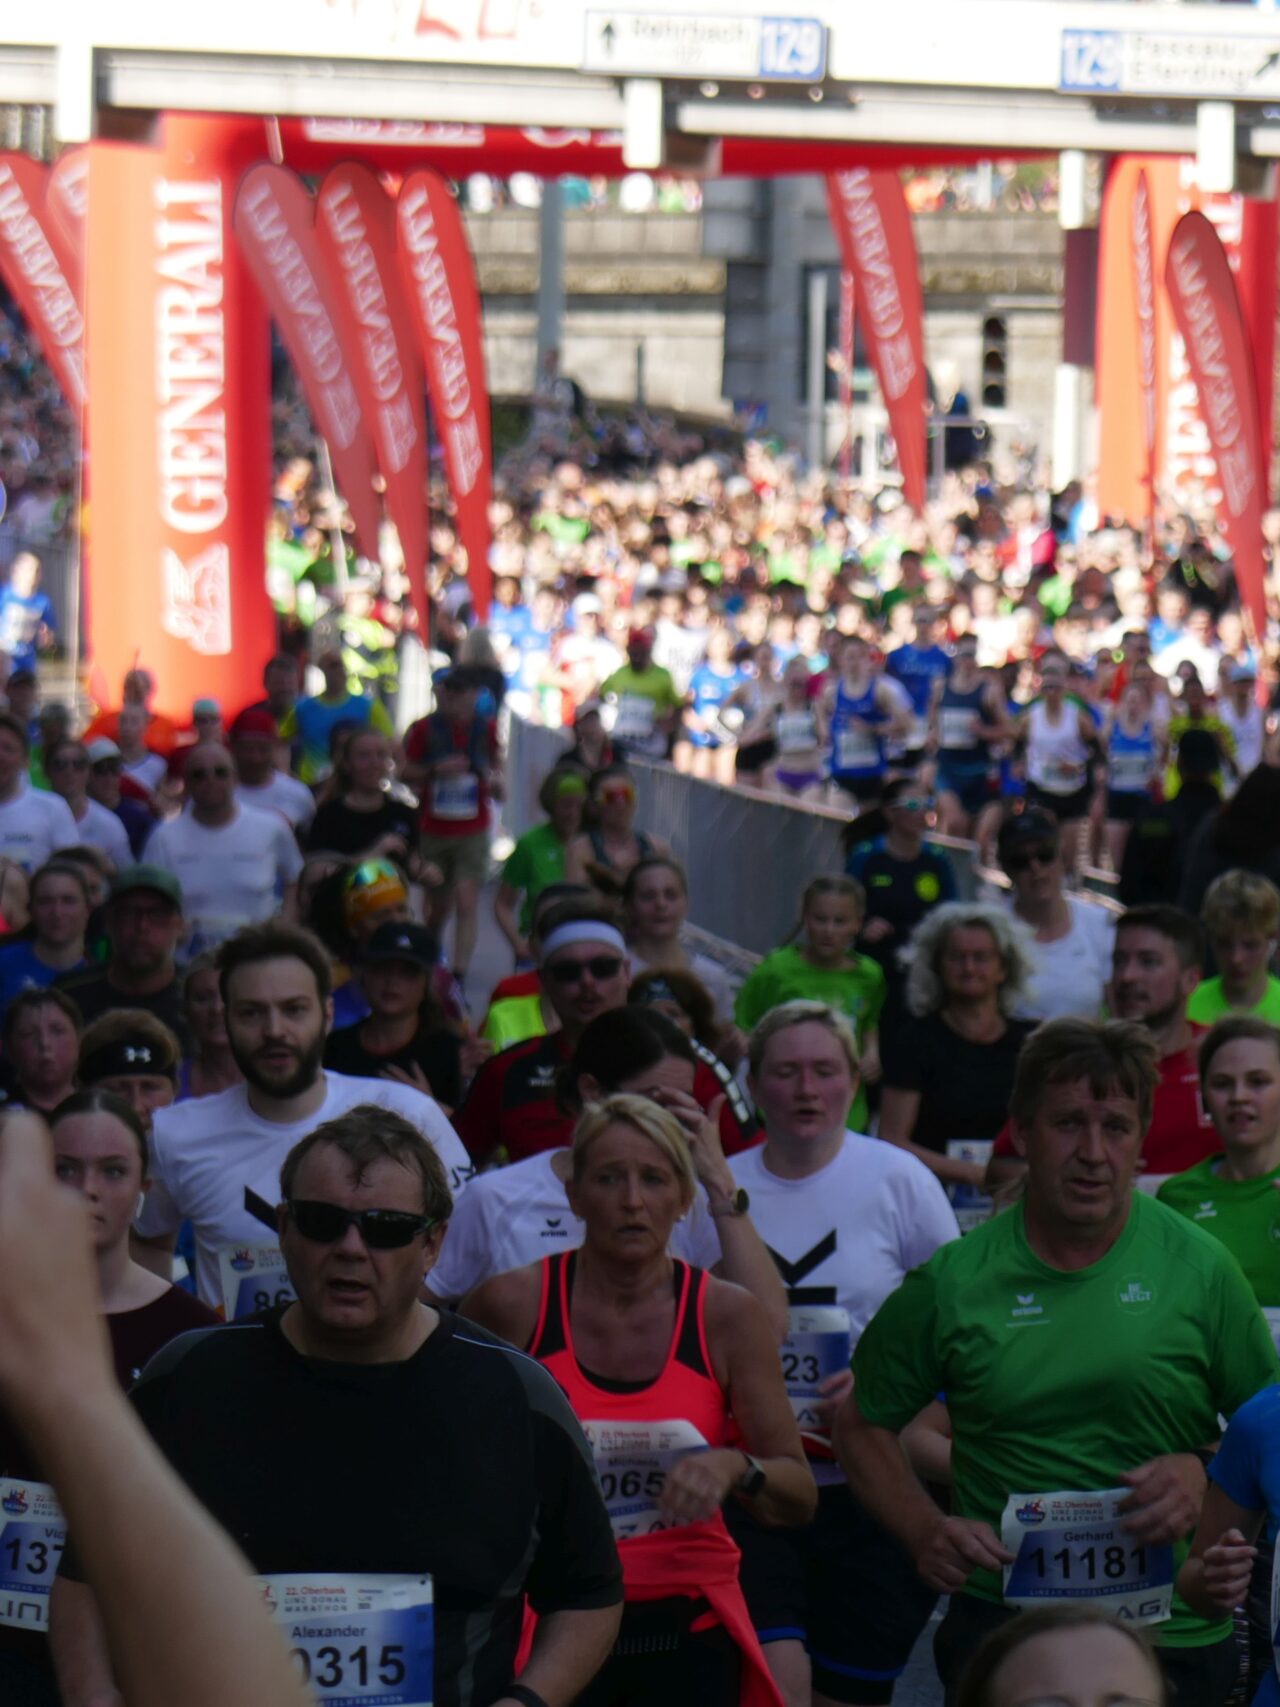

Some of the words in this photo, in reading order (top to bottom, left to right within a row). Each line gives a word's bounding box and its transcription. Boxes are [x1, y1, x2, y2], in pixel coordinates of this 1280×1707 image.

[761, 21, 820, 75] 129
[1064, 35, 1119, 86] 129
[155, 178, 229, 534] GENERALI
[782, 1354, 820, 1383] 23
[600, 1471, 667, 1501] 065
[1063, 1531, 1114, 1543] Gerhard
[1028, 1546, 1147, 1580] 11181
[1117, 1599, 1161, 1619] AG
[292, 1625, 366, 1639] Alexander
[289, 1644, 406, 1688] 0315
